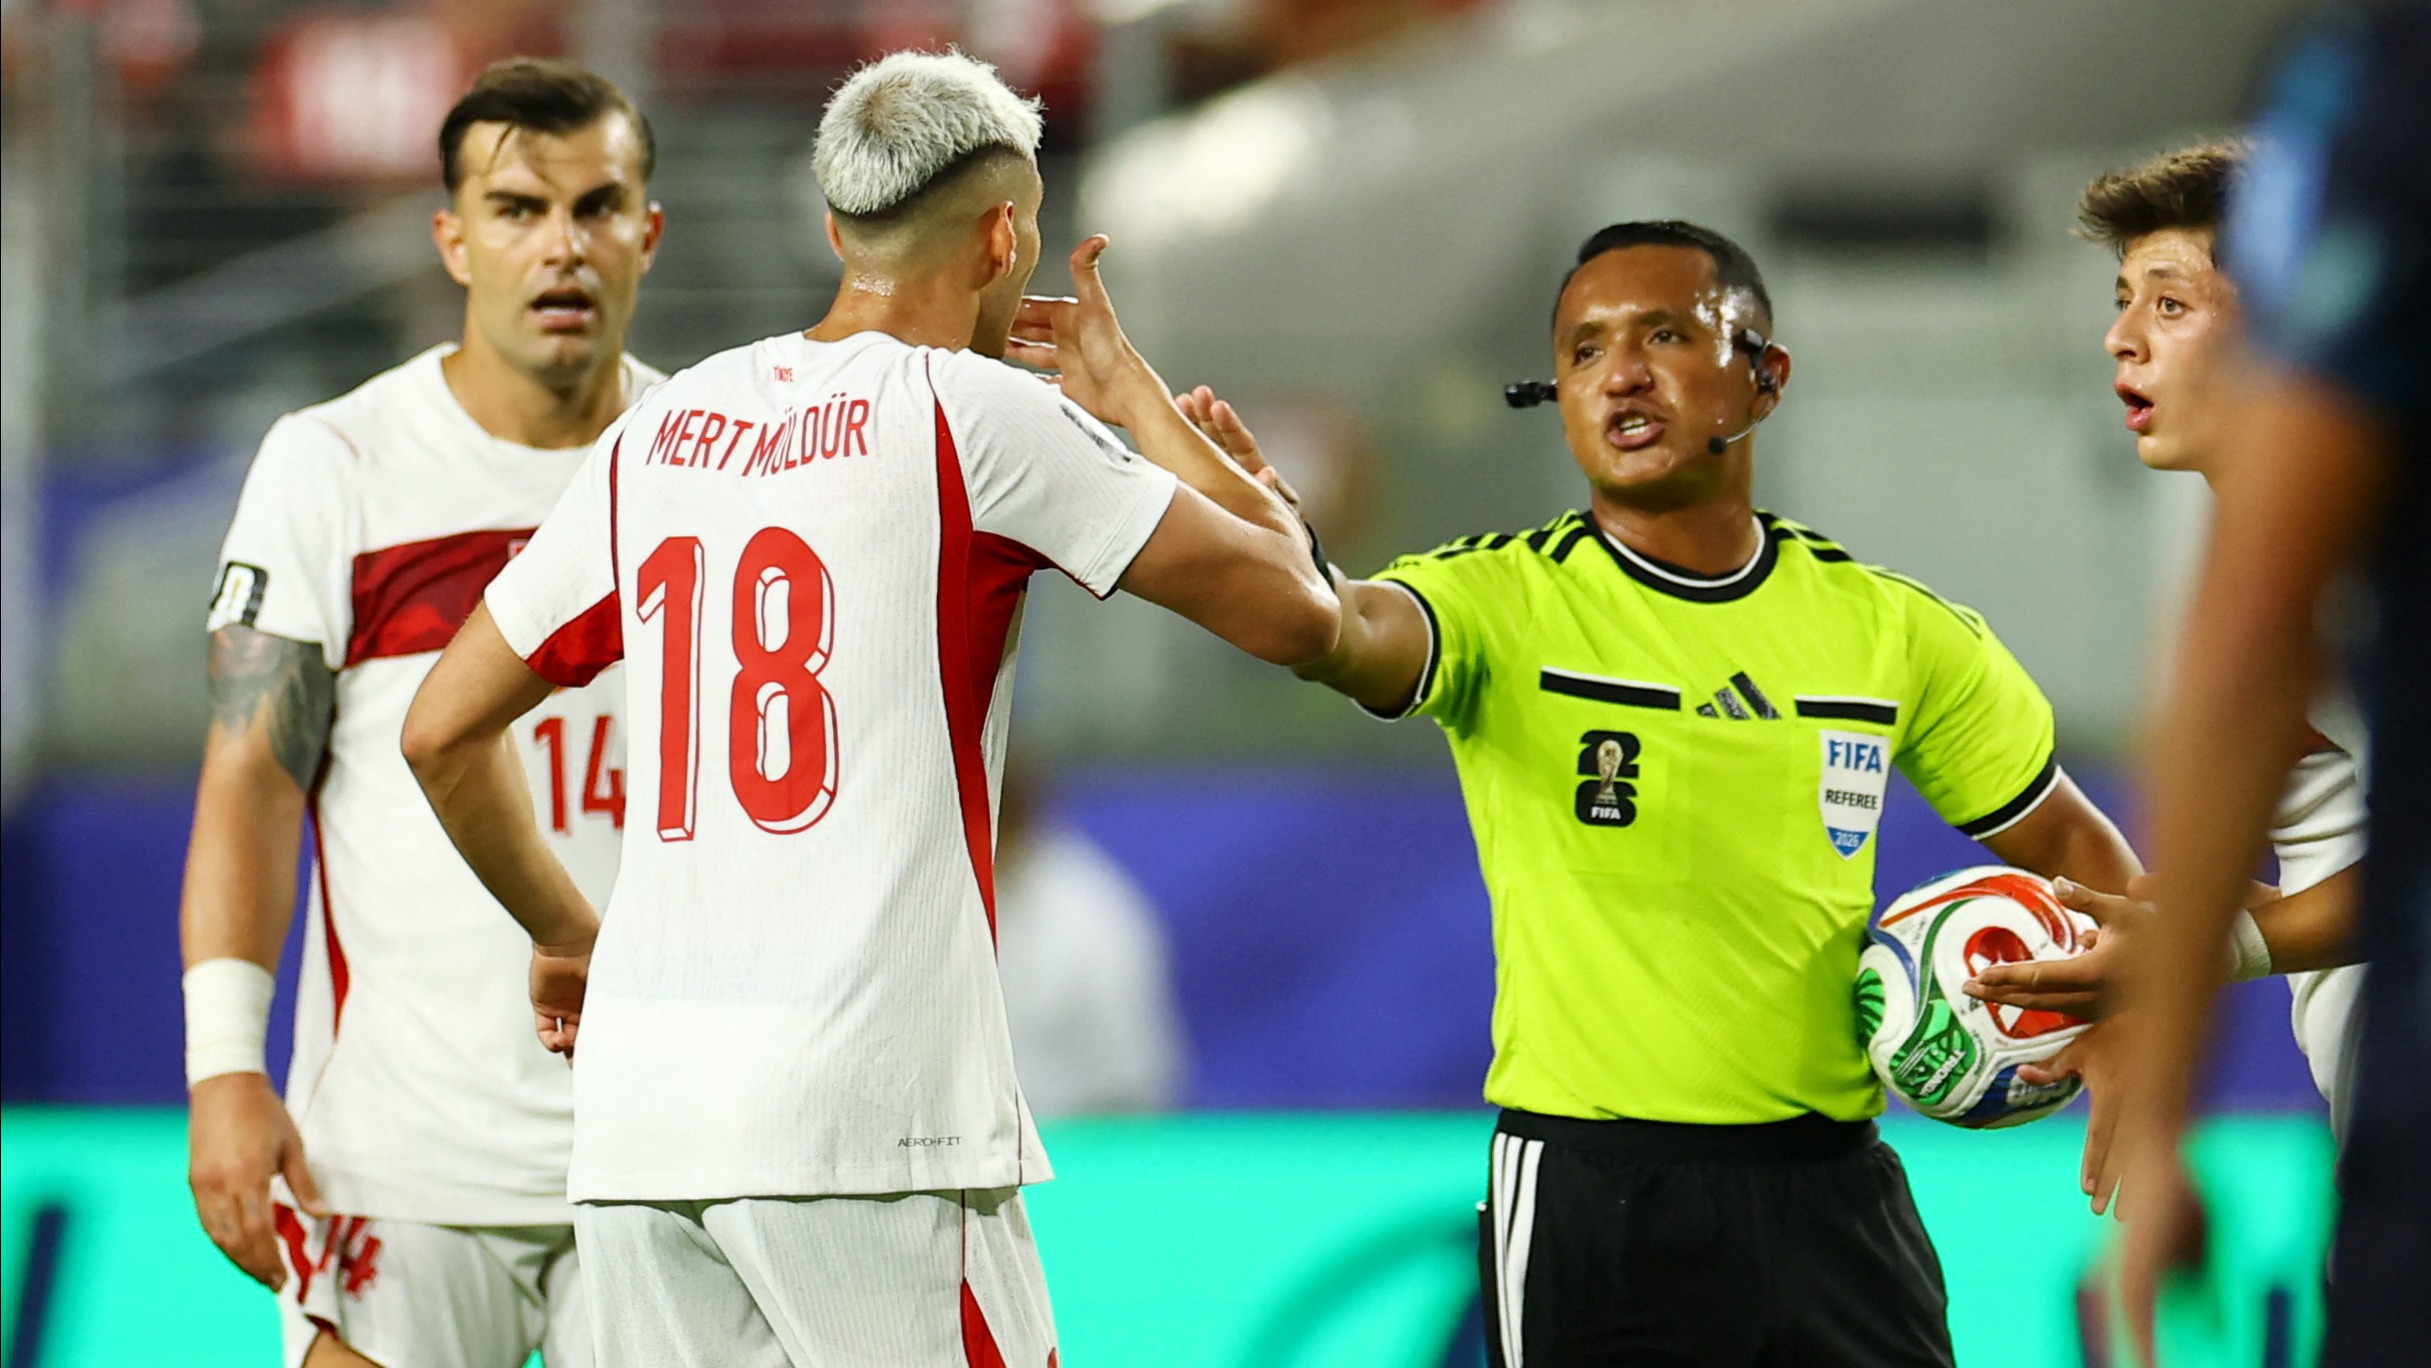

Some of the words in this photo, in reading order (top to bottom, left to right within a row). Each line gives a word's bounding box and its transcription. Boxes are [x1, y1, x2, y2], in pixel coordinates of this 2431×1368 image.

[646, 409, 754, 470] MERT
[741, 392, 870, 477] MÜLDÜR
[636, 526, 839, 842] 18
[534, 714, 627, 837] 14
[1828, 739, 1882, 773] FIFA
[1591, 806, 1622, 820] FIFA
[1825, 789, 1878, 810] REFEREE
